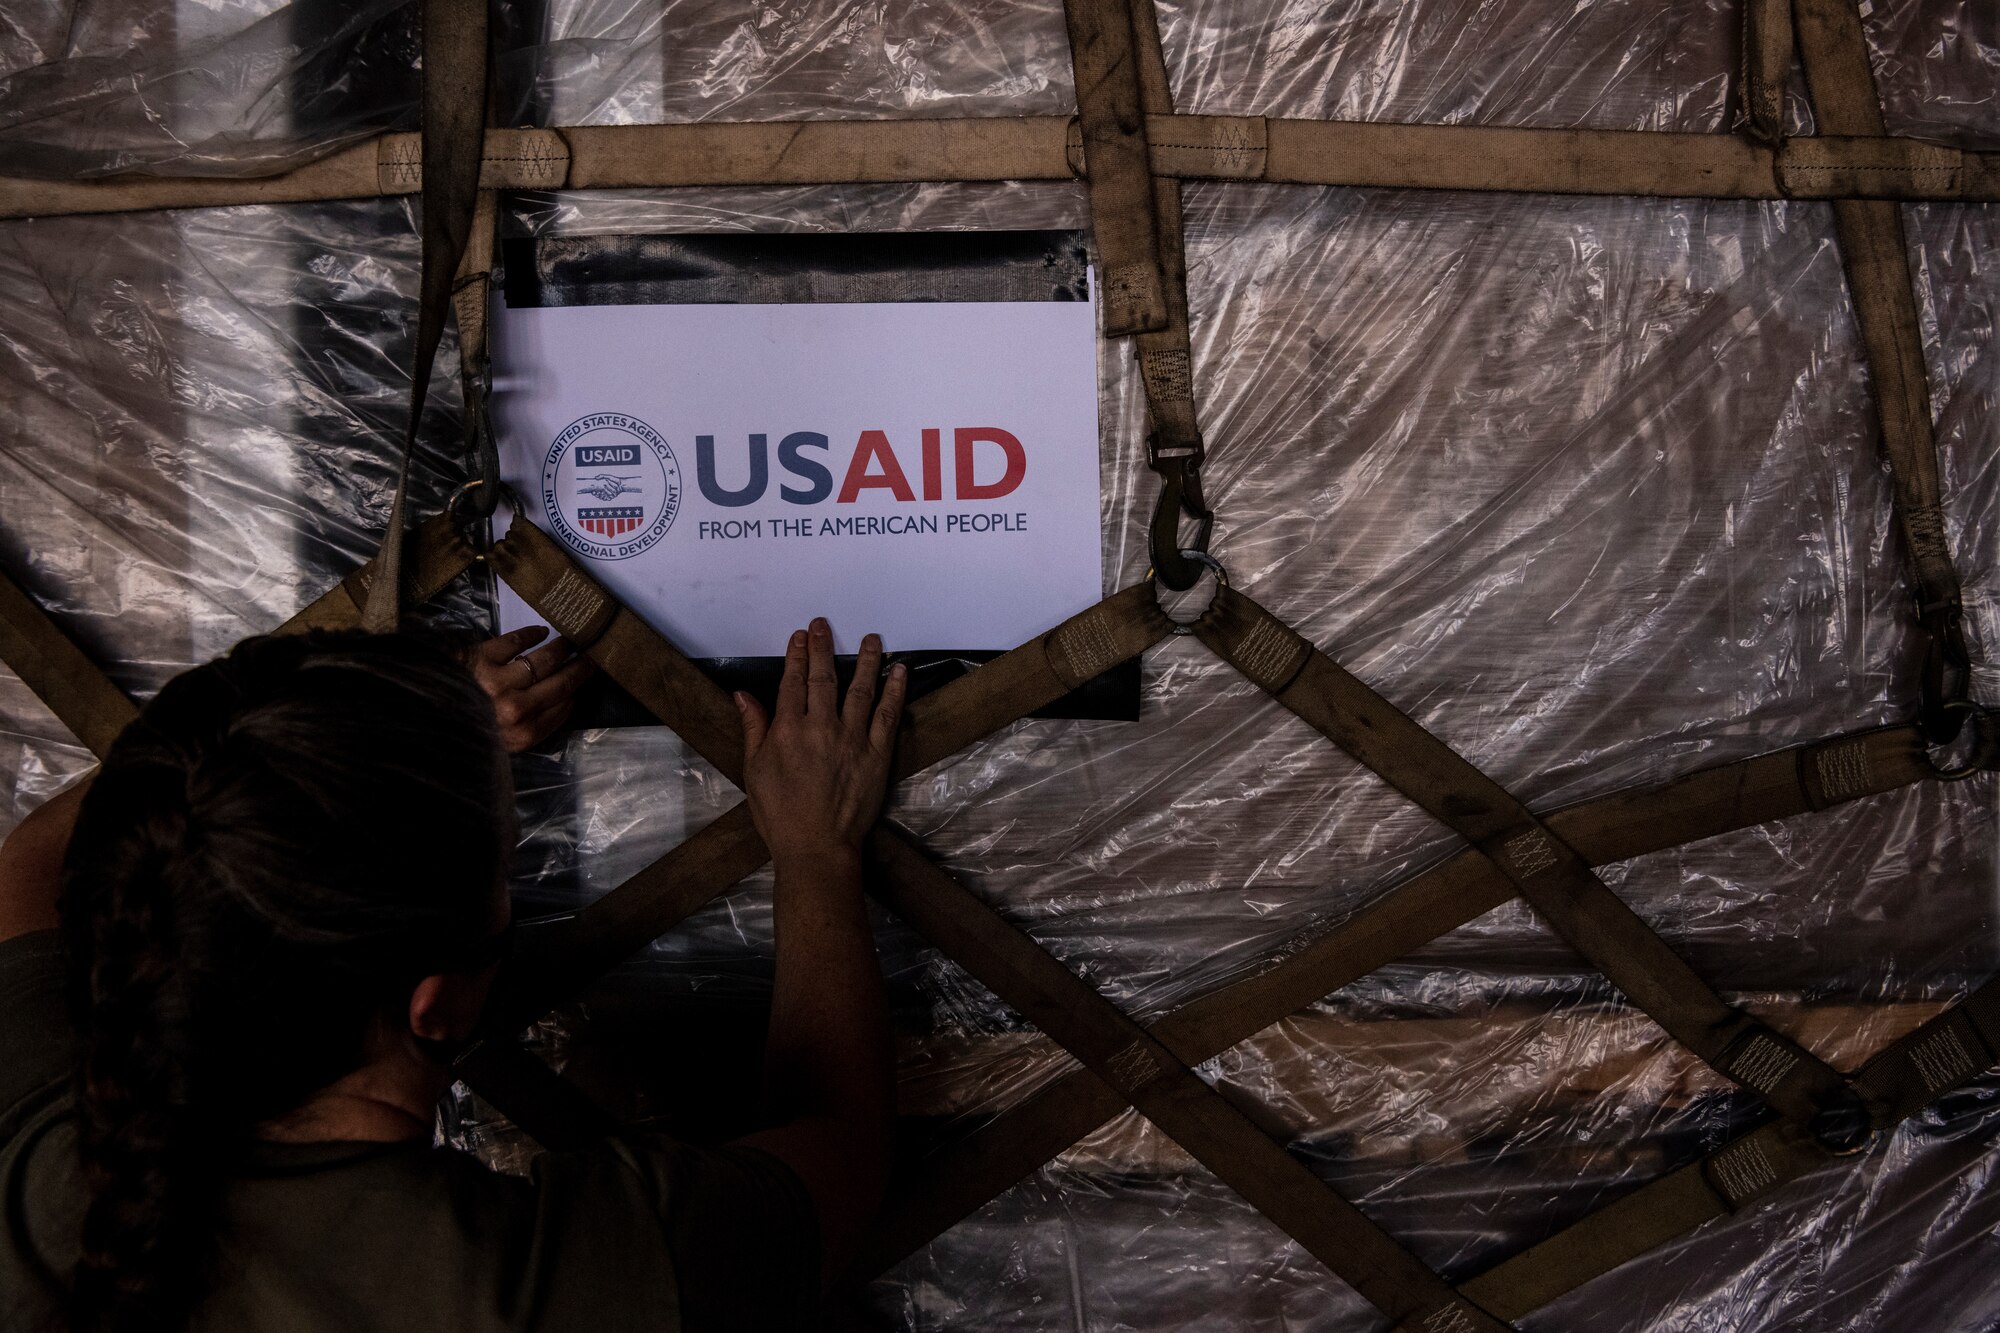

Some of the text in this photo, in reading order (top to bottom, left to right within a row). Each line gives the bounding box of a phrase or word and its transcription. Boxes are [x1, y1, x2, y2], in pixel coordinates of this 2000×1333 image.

[548, 415, 673, 465] UNITED STATES AGENCY
[581, 448, 634, 463] USAID
[695, 426, 1027, 508] USAID
[545, 484, 678, 557] INTERNATIONAL DEVELOPMENT
[699, 512, 1028, 540] FROM THE AMERICAN PEOPLE
